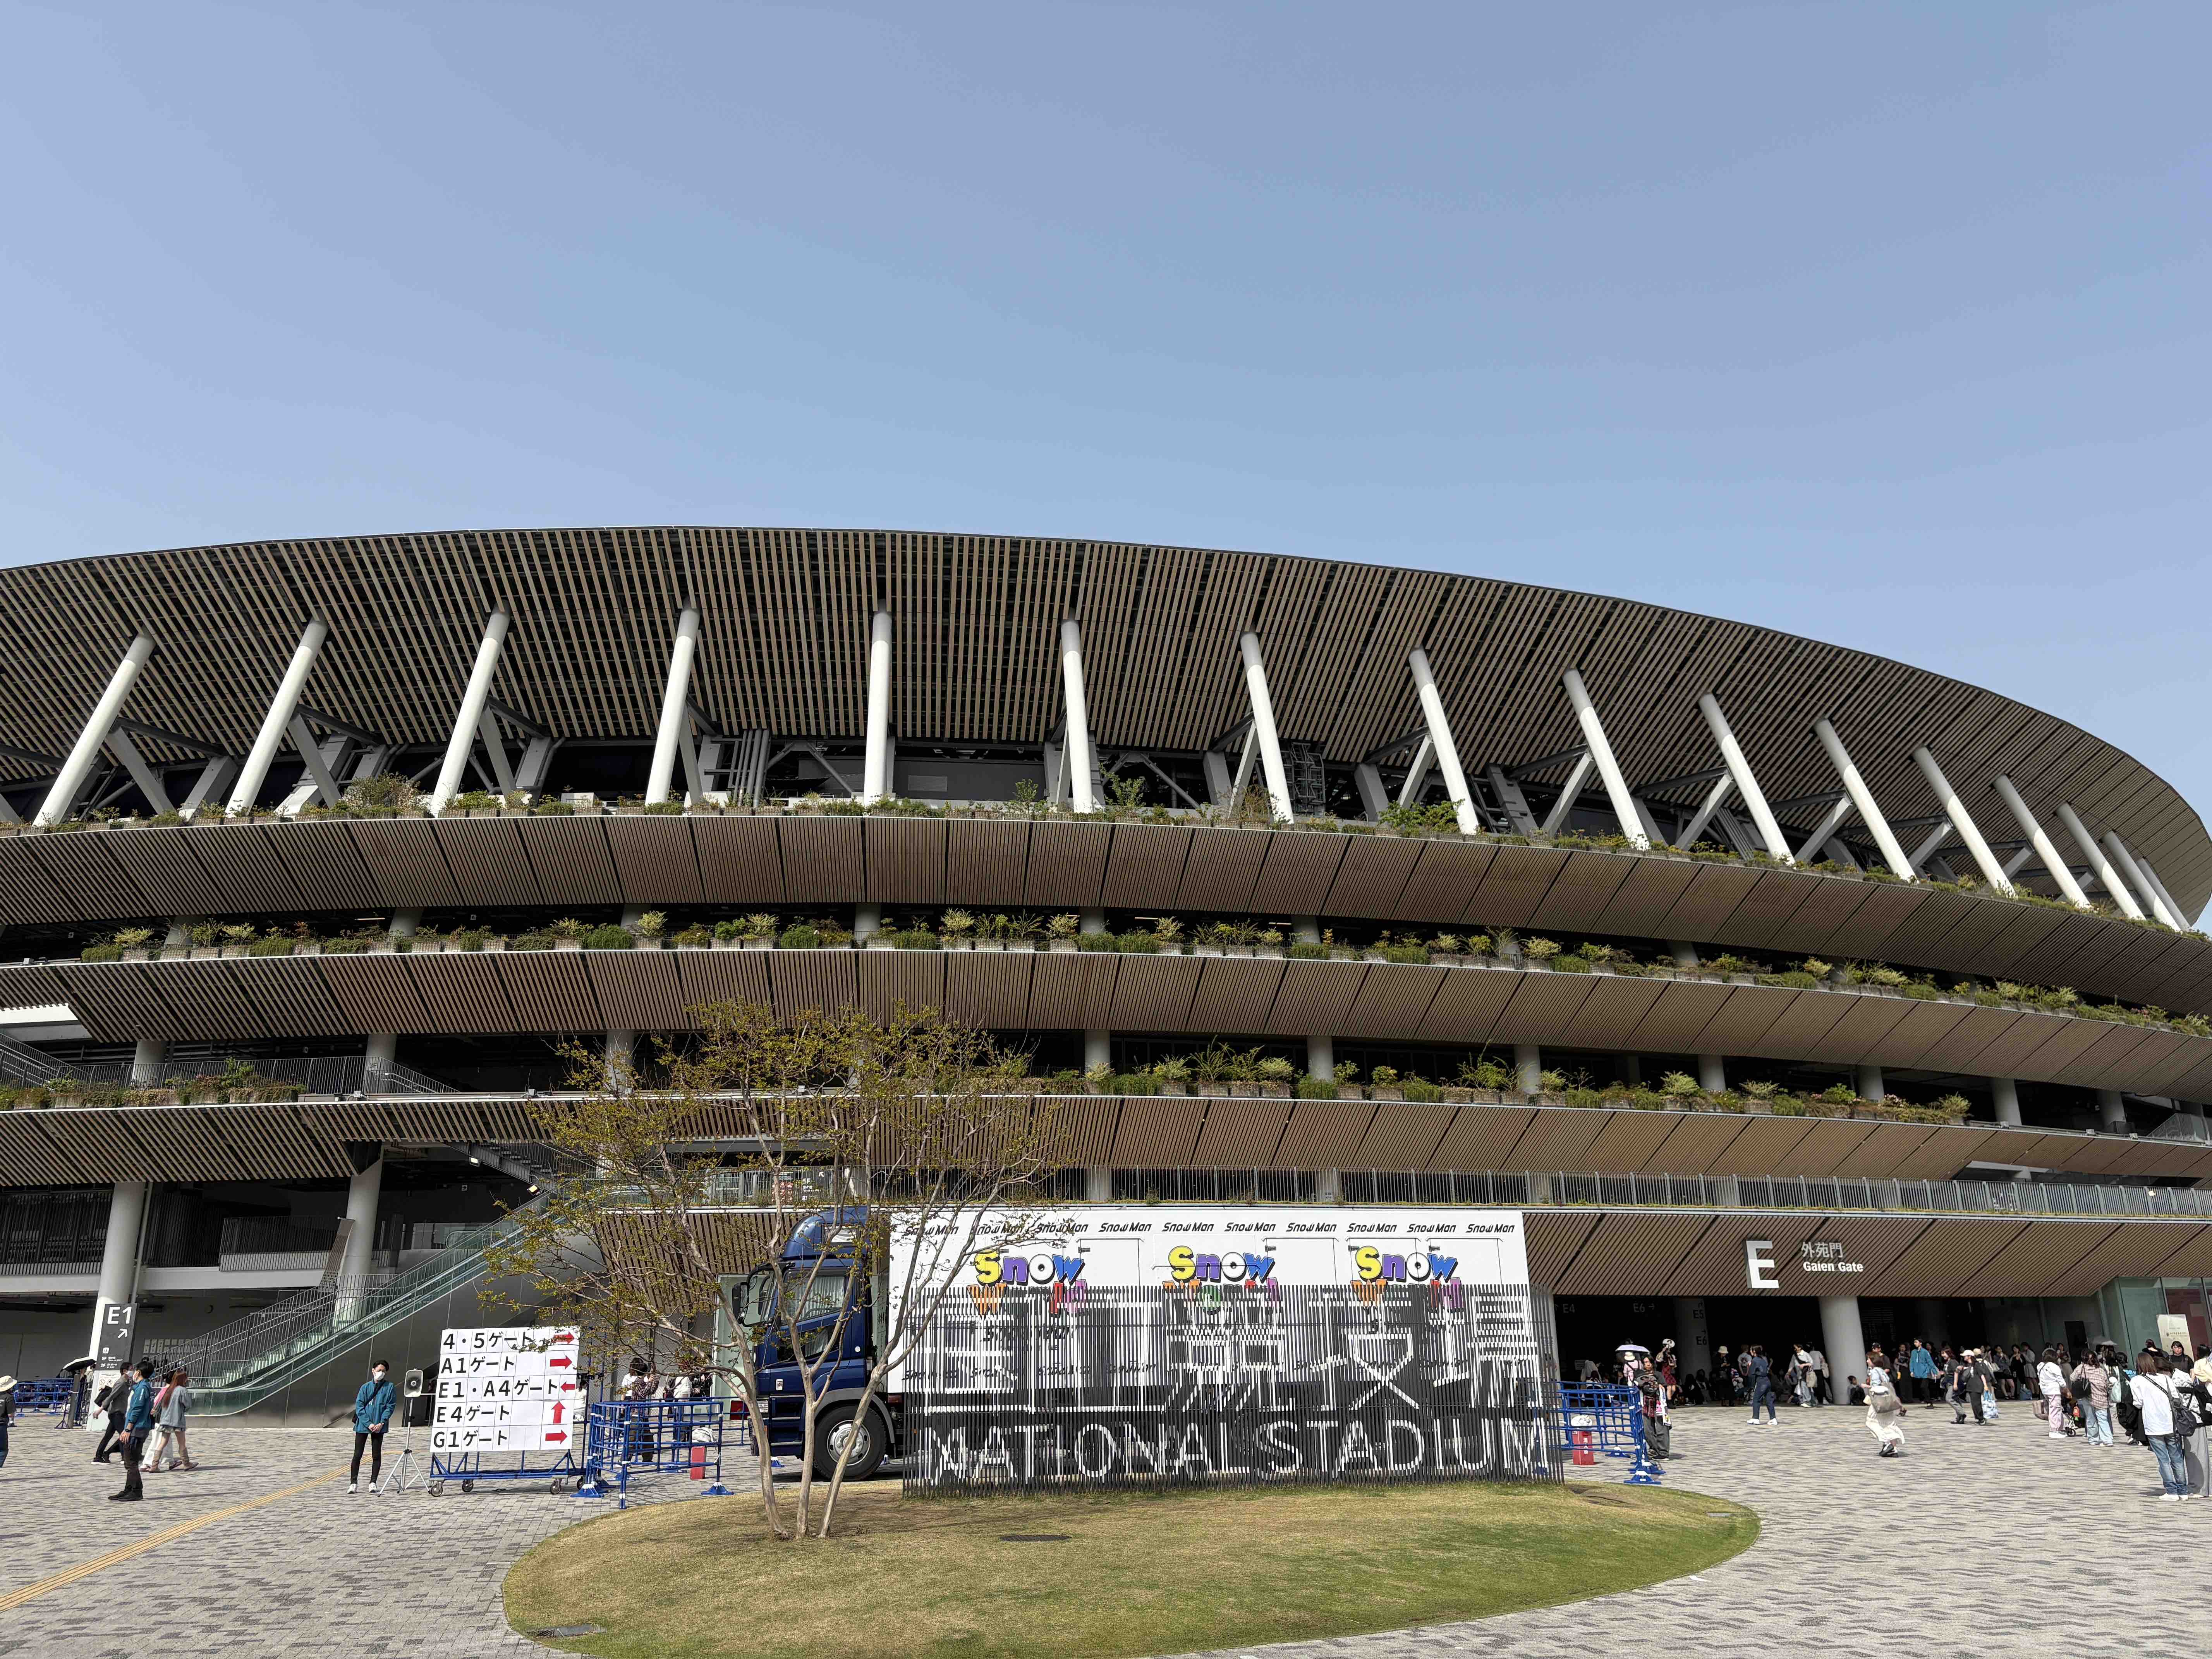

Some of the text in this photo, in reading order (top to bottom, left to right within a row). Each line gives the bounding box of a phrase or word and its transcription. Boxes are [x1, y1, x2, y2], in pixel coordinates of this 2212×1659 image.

[1801, 1242, 1843, 1258] 外苑門
[974, 1249, 1085, 1286] Snow
[1168, 1245, 1275, 1283] Snow
[1355, 1245, 1458, 1283] Snow
[1746, 1240, 1779, 1289] E
[1803, 1261, 1864, 1272] Gaien Gate
[107, 1306, 132, 1324] E1
[1563, 1304, 1575, 1314] E4
[1633, 1303, 1645, 1313] E6
[443, 1331, 535, 1350] 4・5ゲート
[441, 1356, 514, 1374] A1ゲート
[439, 1379, 558, 1398] E1・A4ゲート
[436, 1405, 510, 1423] E4ゲート
[433, 1430, 507, 1448] G1ゲート
[920, 1417, 1549, 1481] NATIONAL STADIUM
